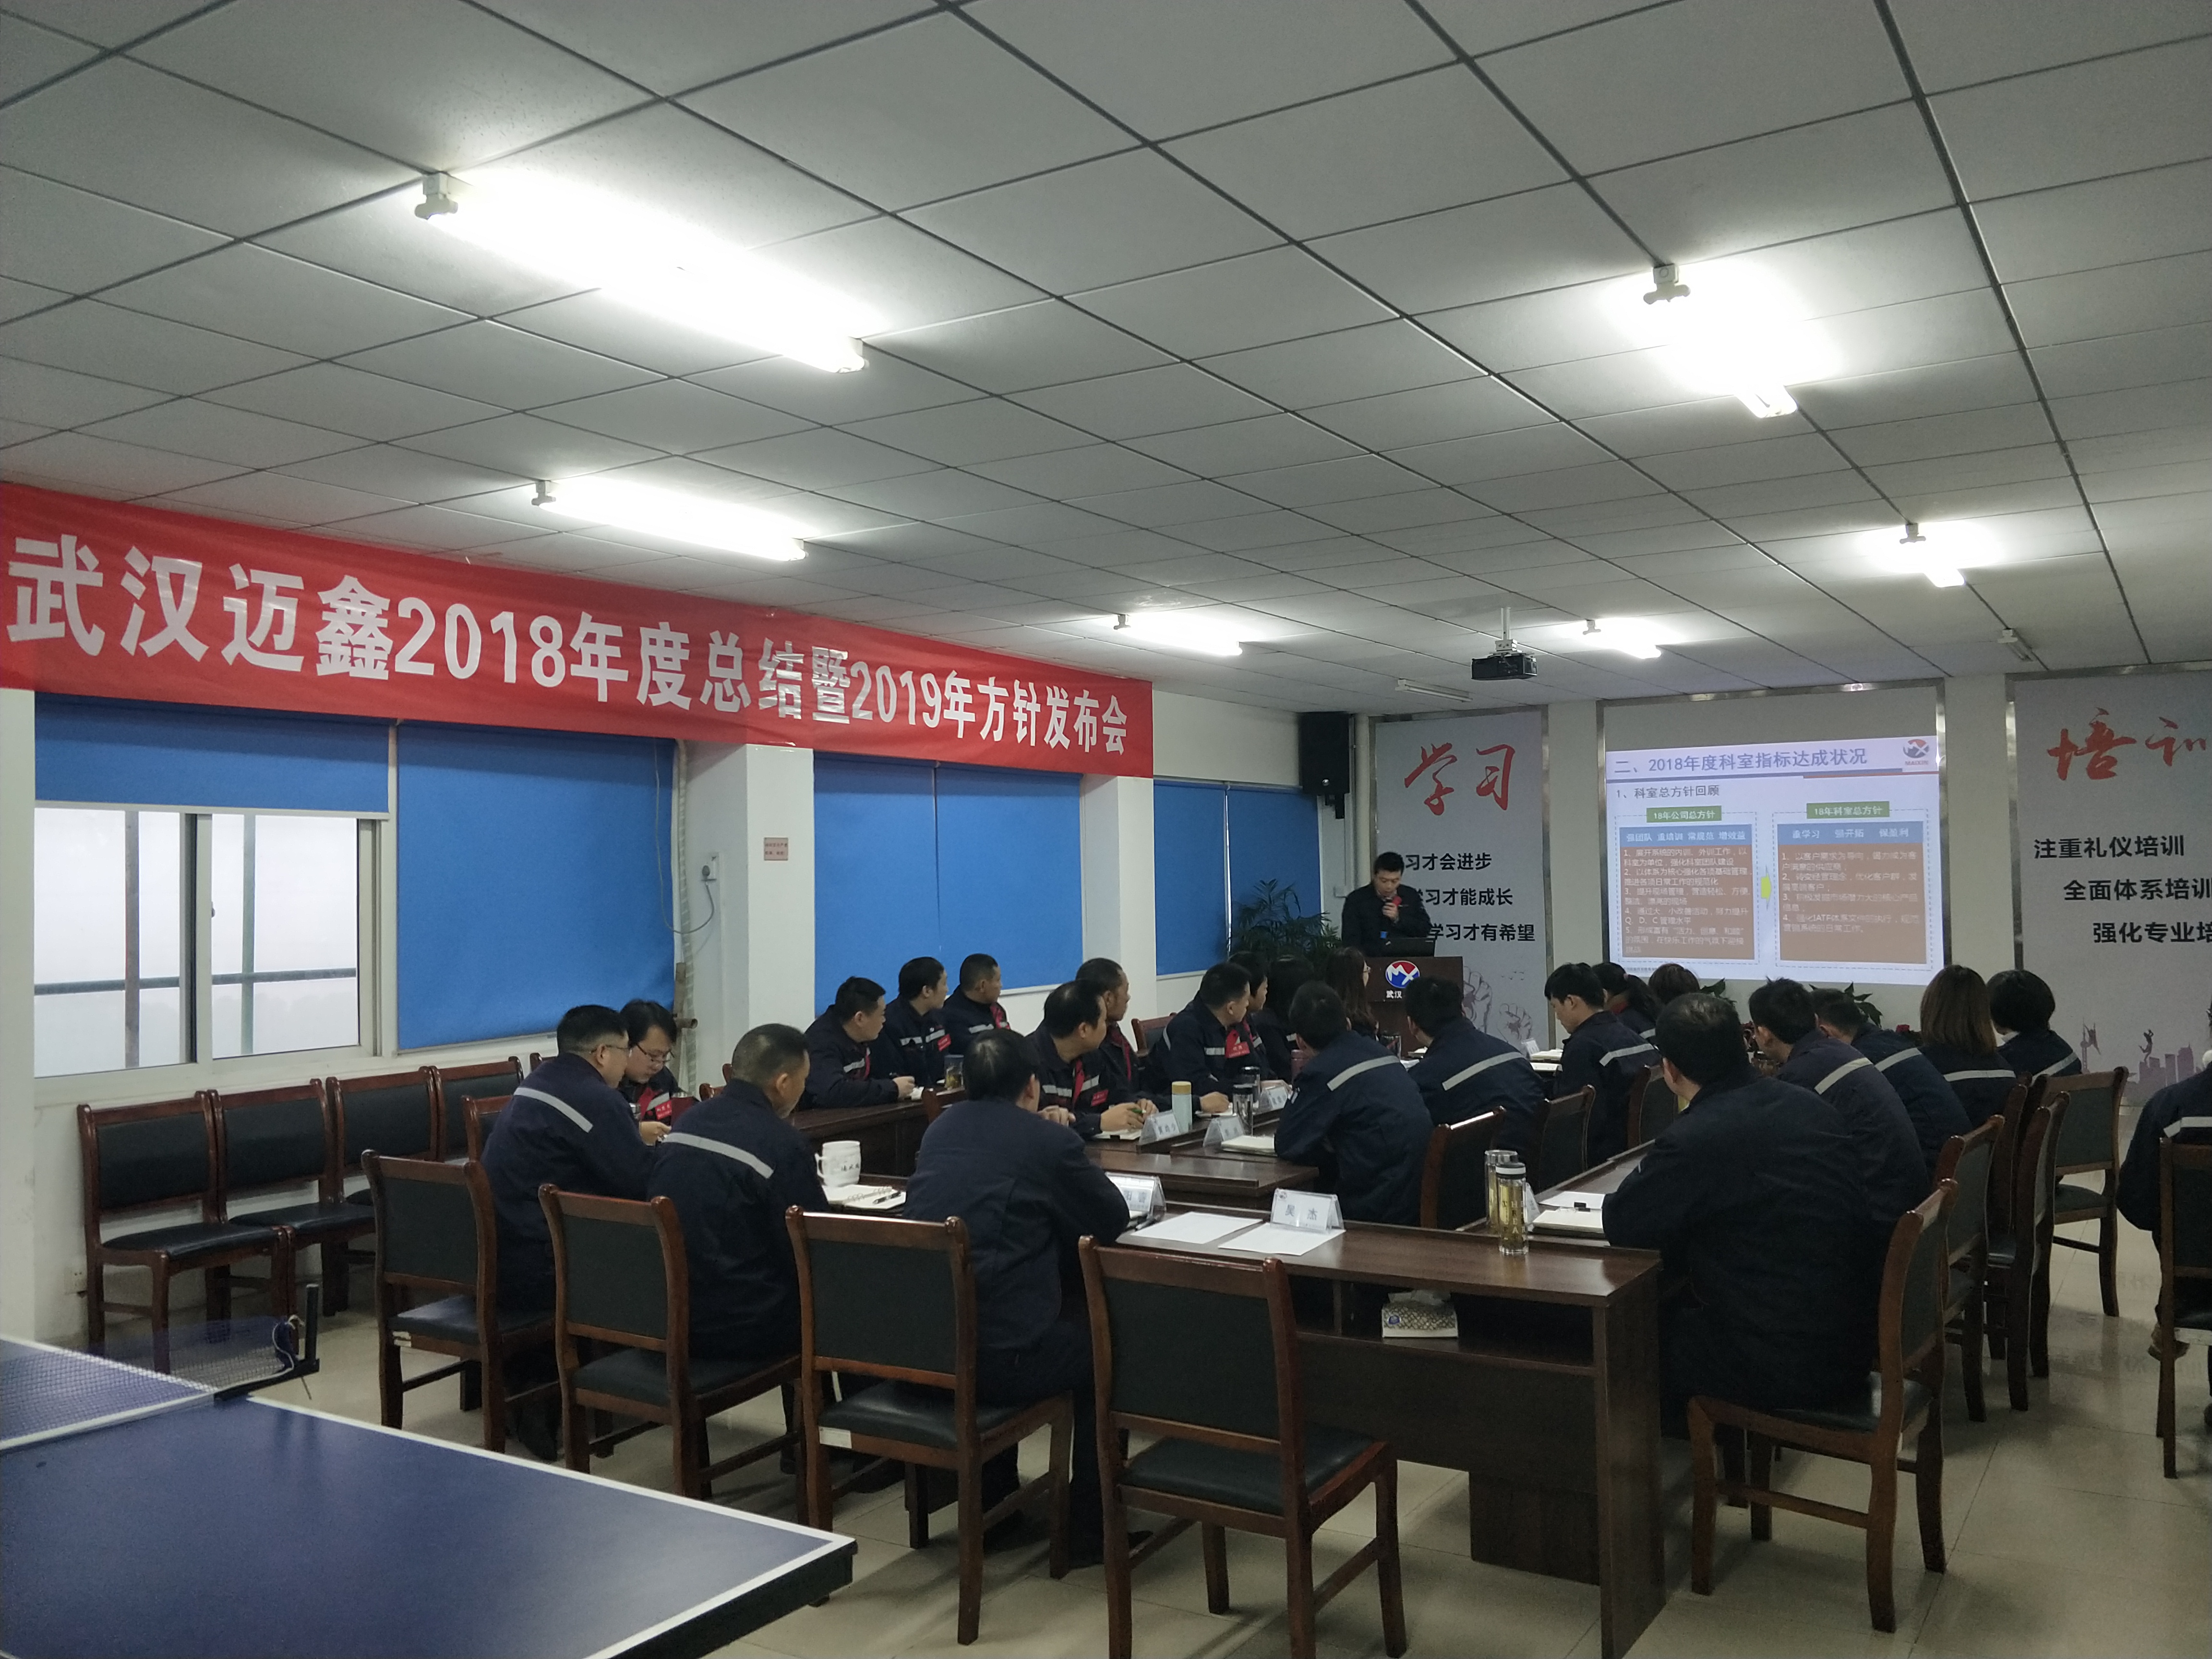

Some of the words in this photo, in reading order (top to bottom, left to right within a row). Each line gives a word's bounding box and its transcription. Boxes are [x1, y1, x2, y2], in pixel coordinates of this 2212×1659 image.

[7, 533, 1127, 755] 武汉迈鑫2018年度总结暨2019年方针发布会
[1614, 748, 1867, 774] 二、2018年度科室指标达成状况
[1404, 742, 1515, 816] 学习
[1616, 784, 1720, 800] 1、科室总方针回顾
[1654, 810, 1716, 819] 18年公司总方针
[1814, 805, 1882, 816] 18年科室总方针
[2033, 835, 2185, 859] 注重礼仪培训
[1405, 852, 1492, 871] 习才会进步
[2063, 878, 2212, 901] 全面体系培训
